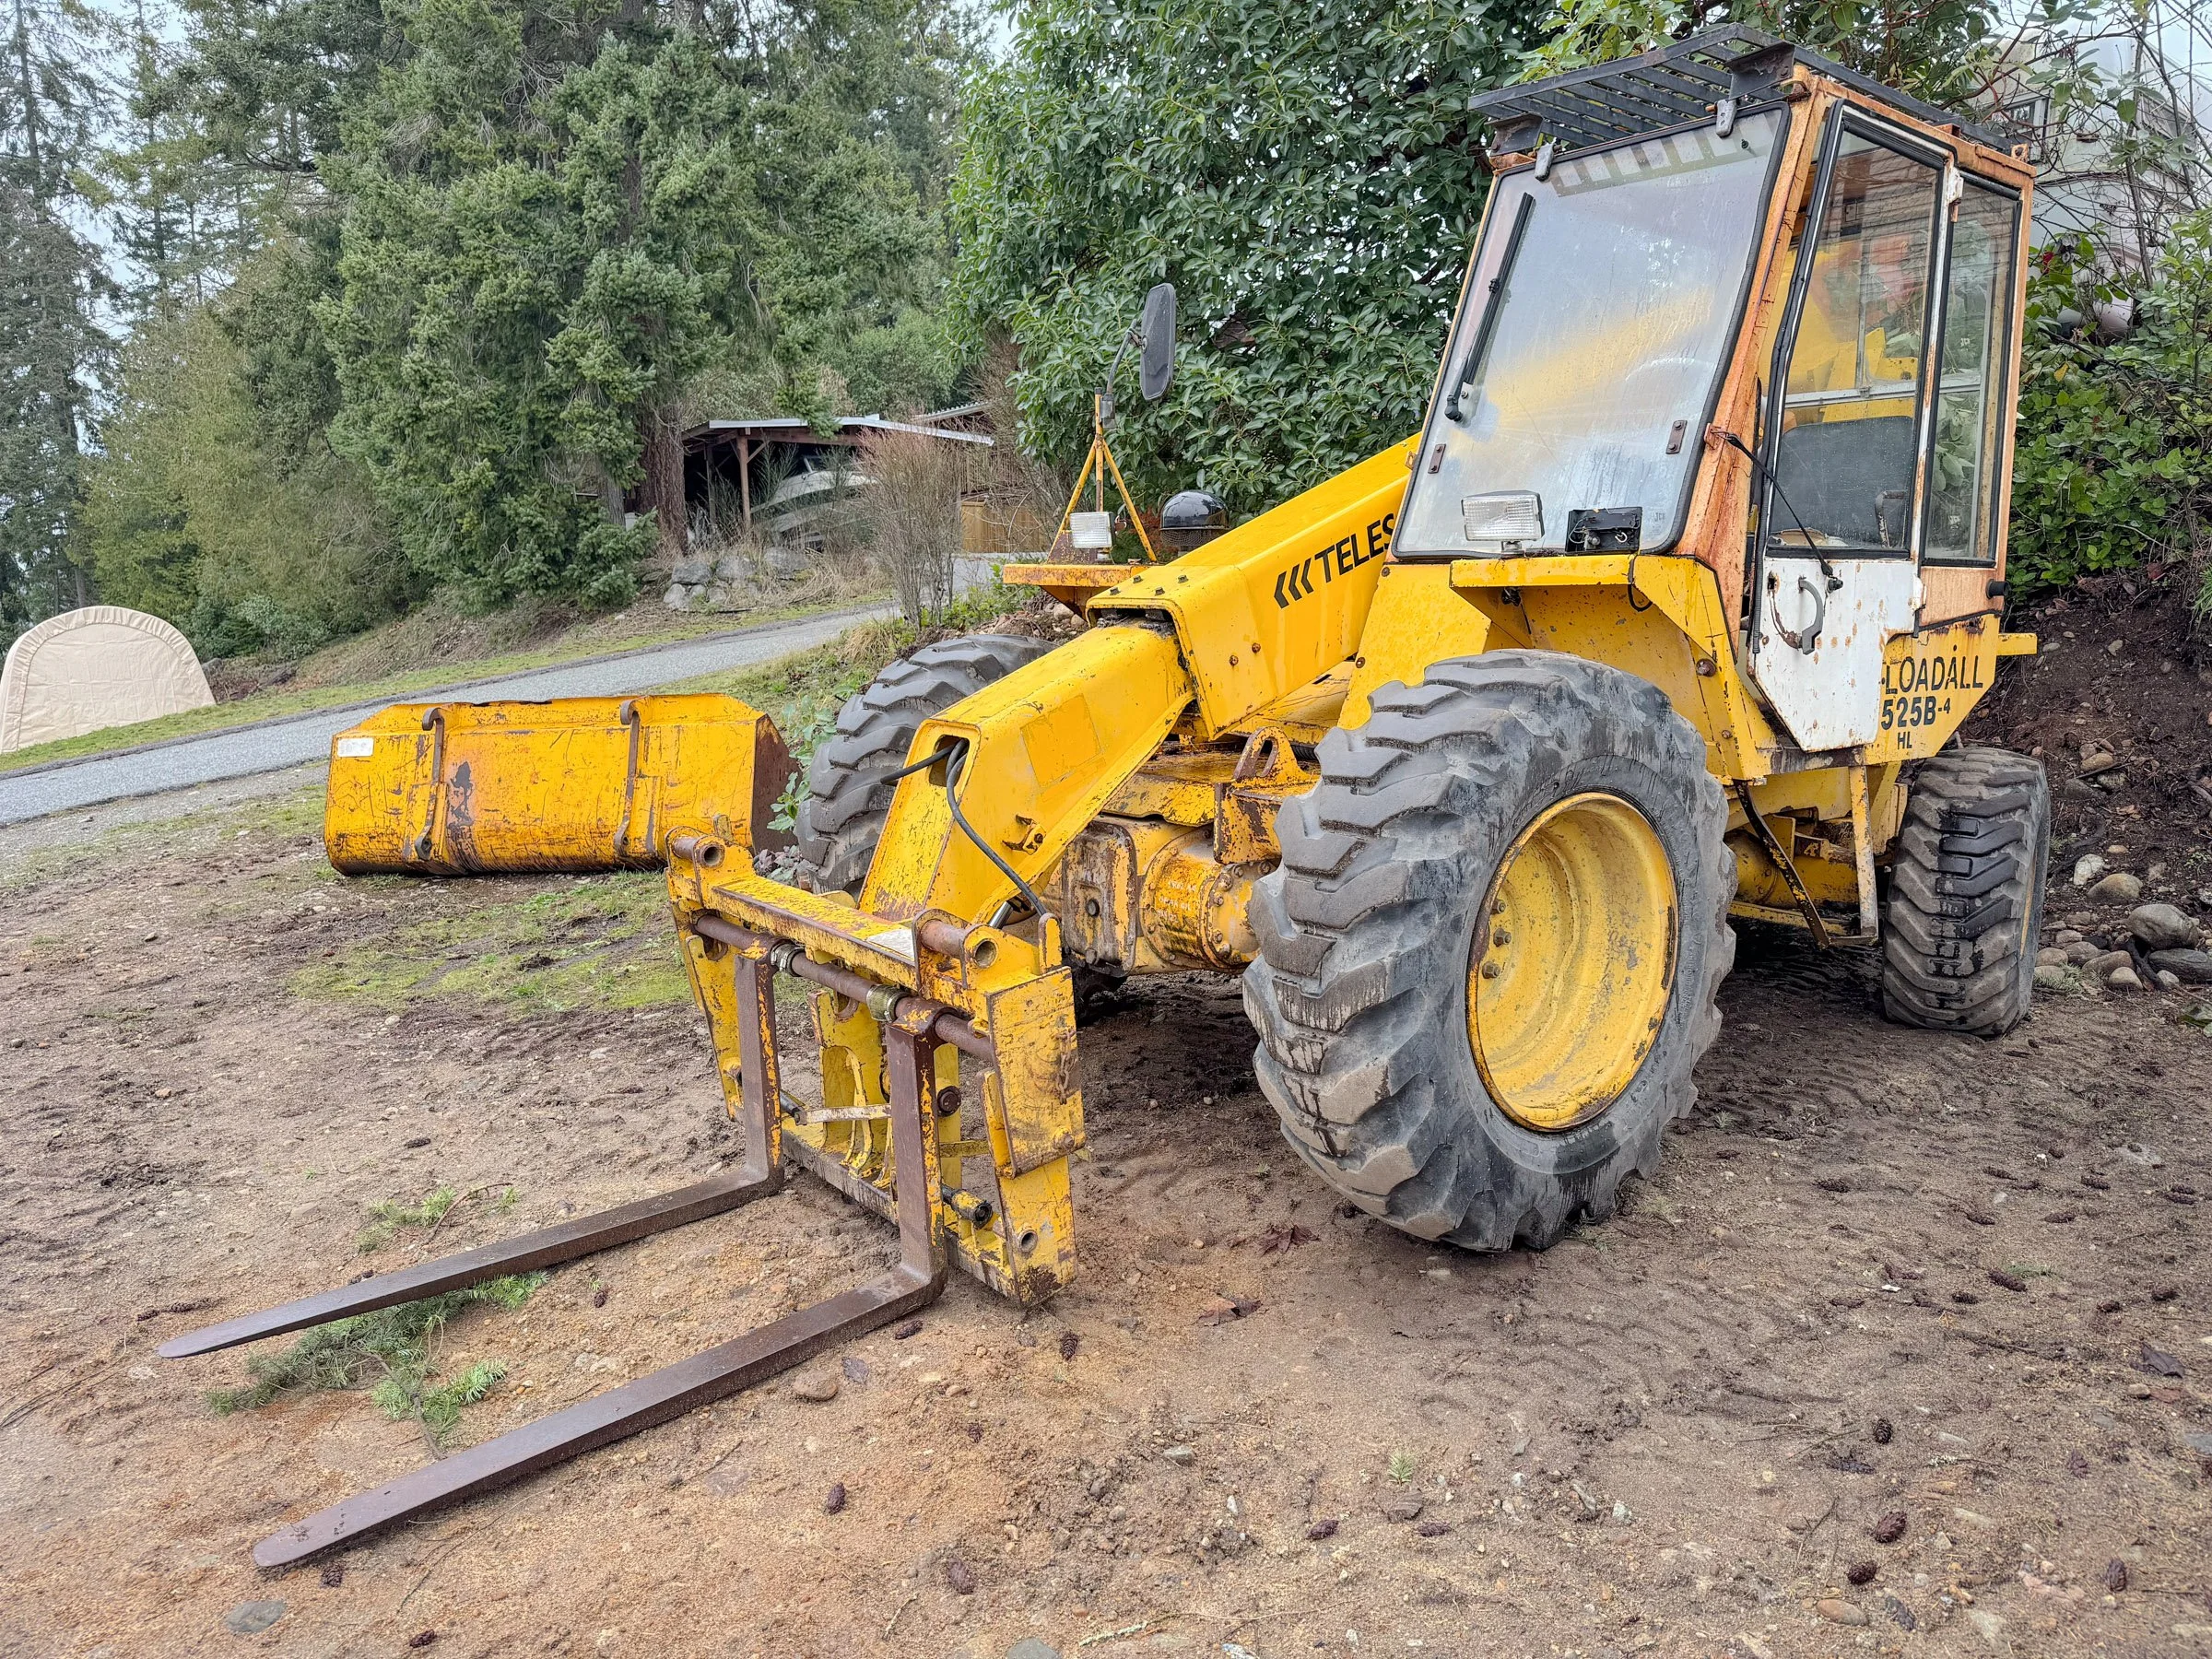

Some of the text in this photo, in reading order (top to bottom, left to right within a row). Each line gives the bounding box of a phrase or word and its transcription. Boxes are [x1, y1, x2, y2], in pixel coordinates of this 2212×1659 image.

[1885, 655, 1983, 695] LOADALL
[1880, 696, 1951, 730] 525B-4
[1897, 732, 1912, 749] HL
